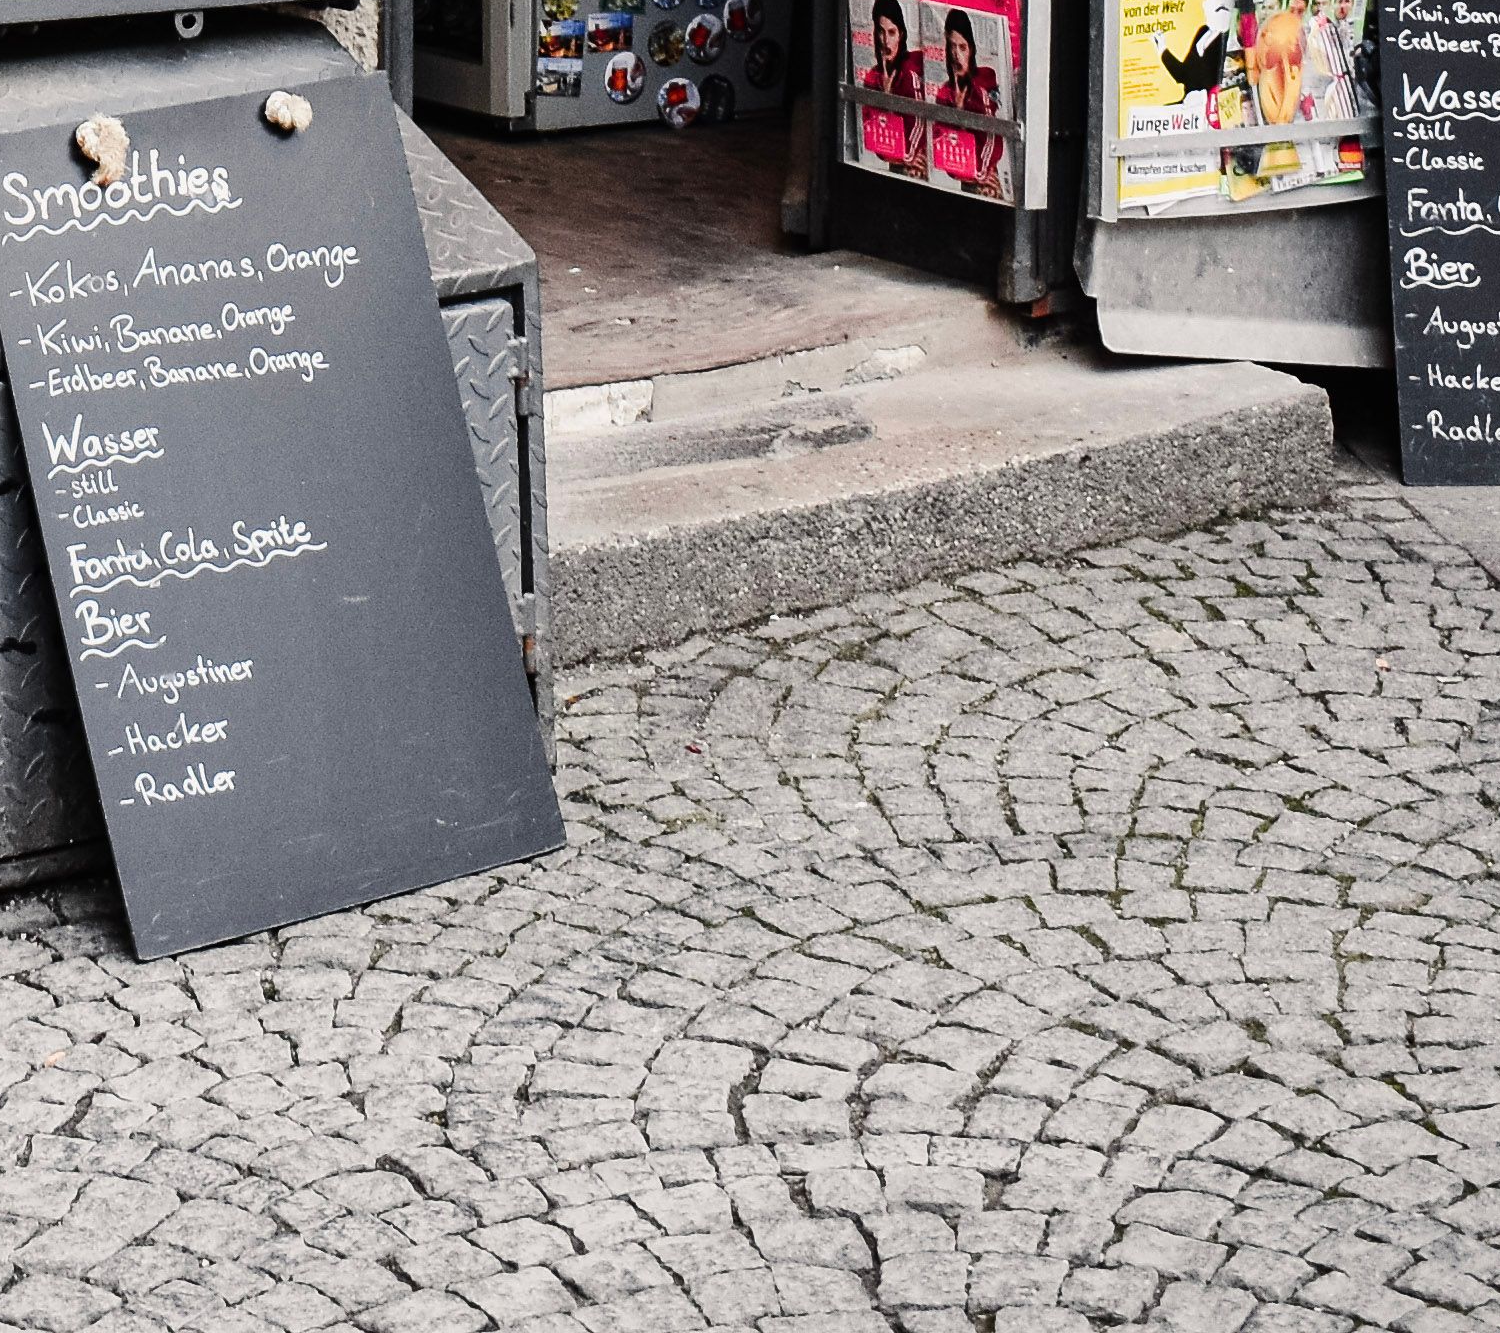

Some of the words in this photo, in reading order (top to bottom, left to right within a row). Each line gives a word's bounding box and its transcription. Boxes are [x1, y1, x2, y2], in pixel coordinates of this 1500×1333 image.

[1123, 25, 1136, 35] zu
[1138, 20, 1176, 34] machen.
[1124, 5, 1141, 16] von
[1143, 3, 1160, 15] der
[1162, 0, 1184, 14] Welt
[2, 148, 231, 225] Smoothies
[266, 243, 360, 287] Orange
[1403, 247, 1475, 283] Bier
[221, 302, 296, 336] Orange
[249, 347, 330, 382] Orange
[41, 413, 159, 465] Wasser
[233, 515, 312, 561] Sprite
[75, 599, 151, 646] Bier
[117, 655, 254, 704] Augustiner
